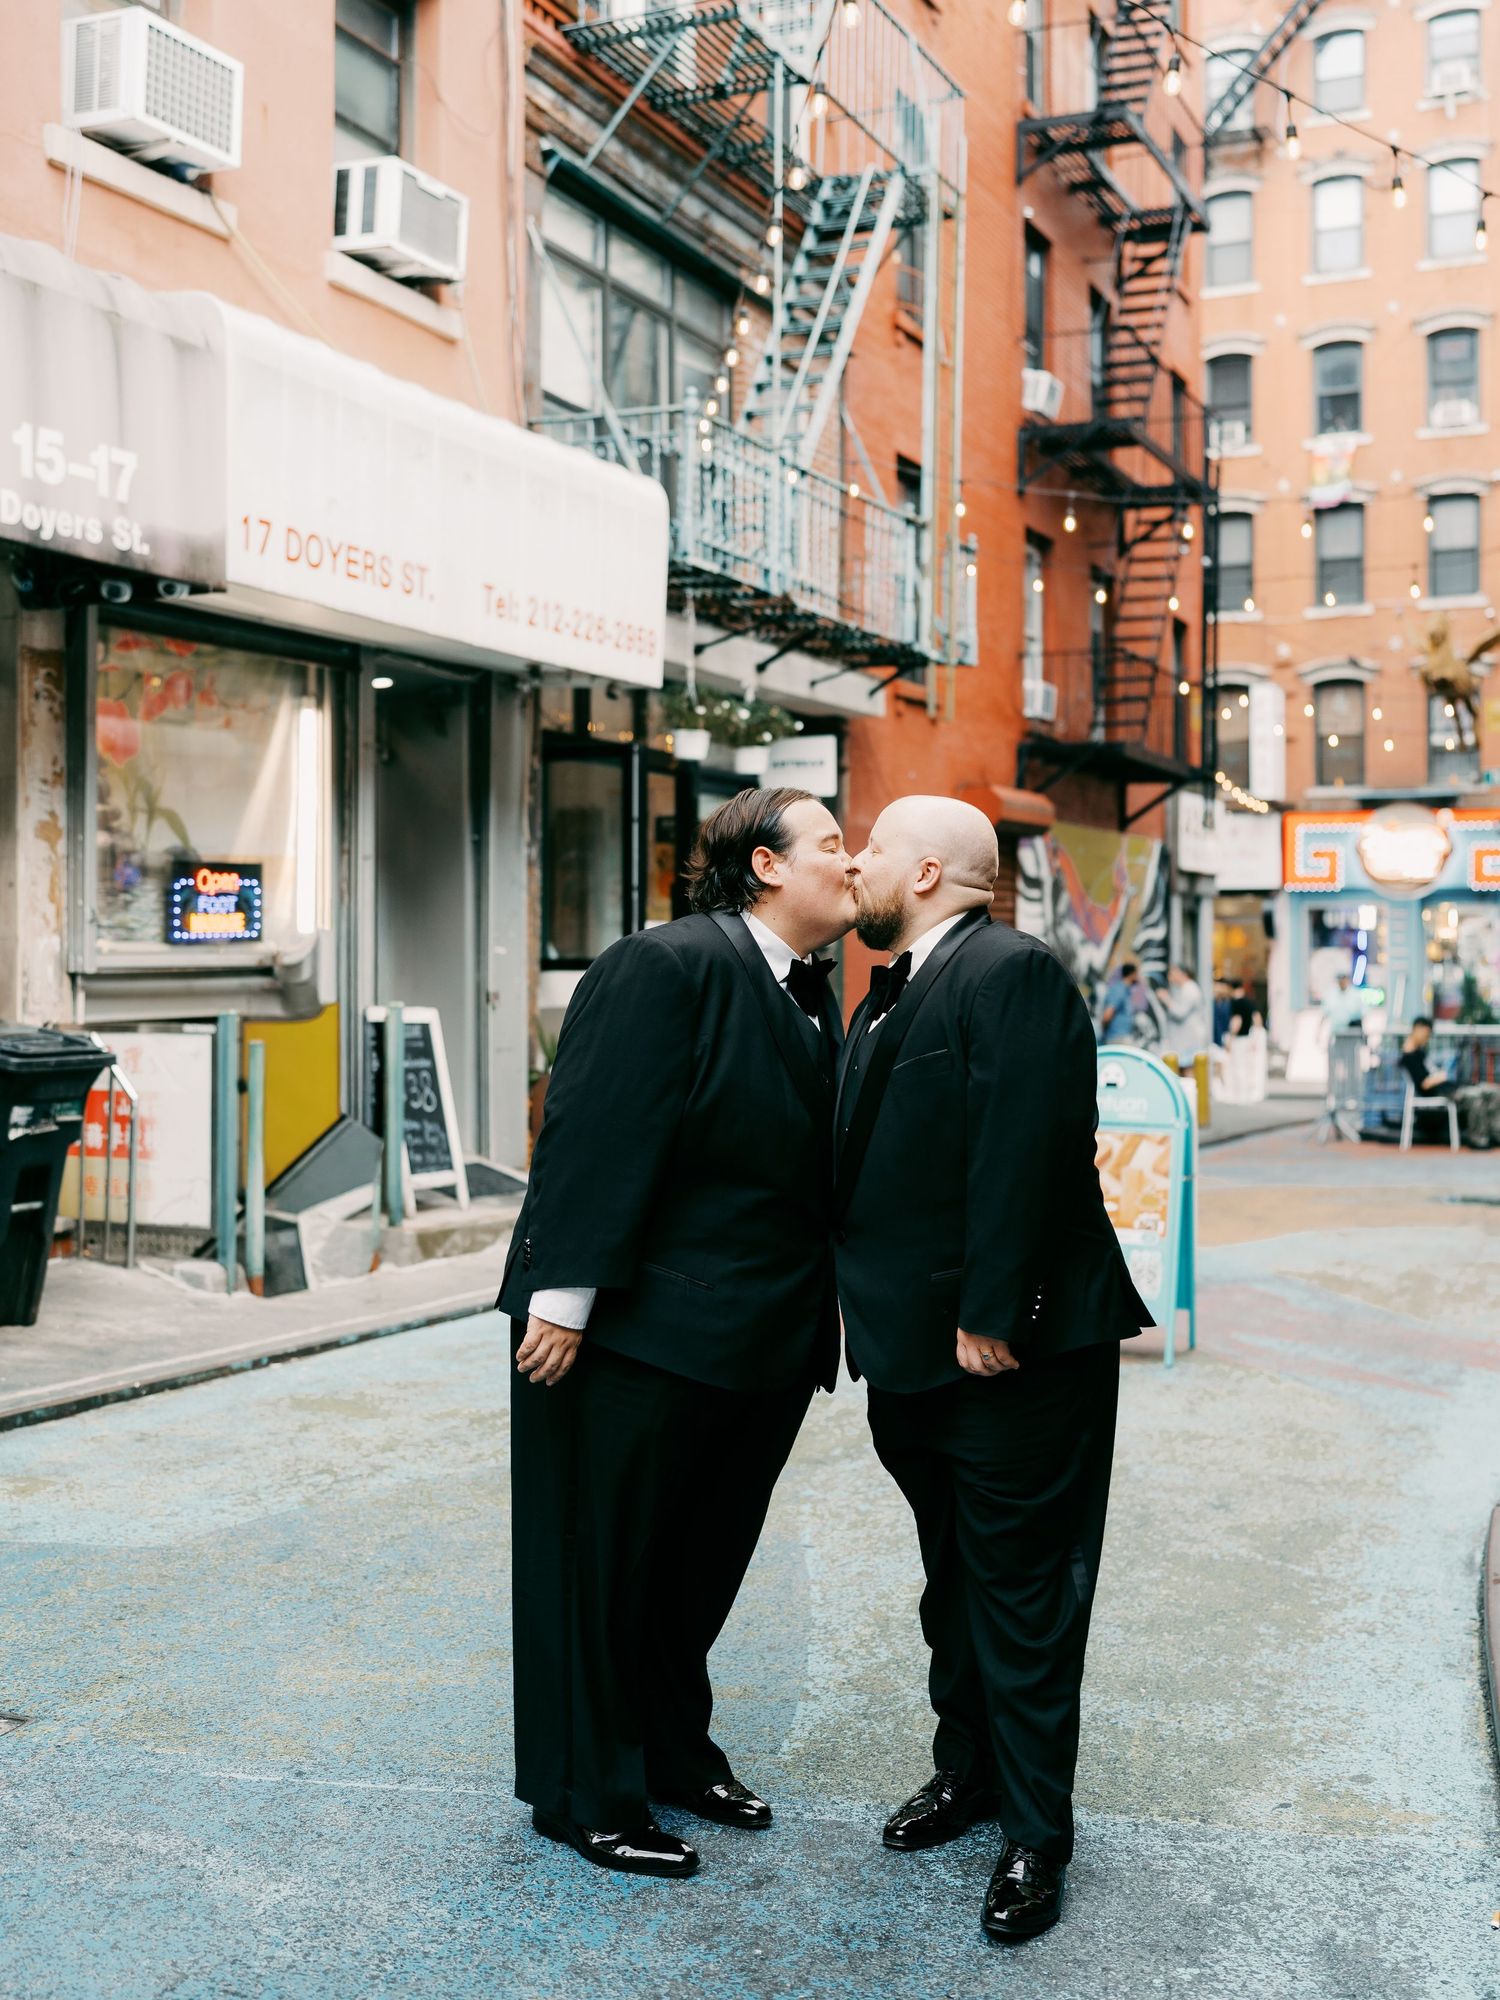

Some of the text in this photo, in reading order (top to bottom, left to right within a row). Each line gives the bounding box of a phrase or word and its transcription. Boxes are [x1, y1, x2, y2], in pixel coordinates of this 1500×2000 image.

[0, 488, 151, 556] Doyers St.
[242, 515, 272, 556] 17
[285, 527, 393, 589] DOYERS
[401, 561, 435, 601] ST.
